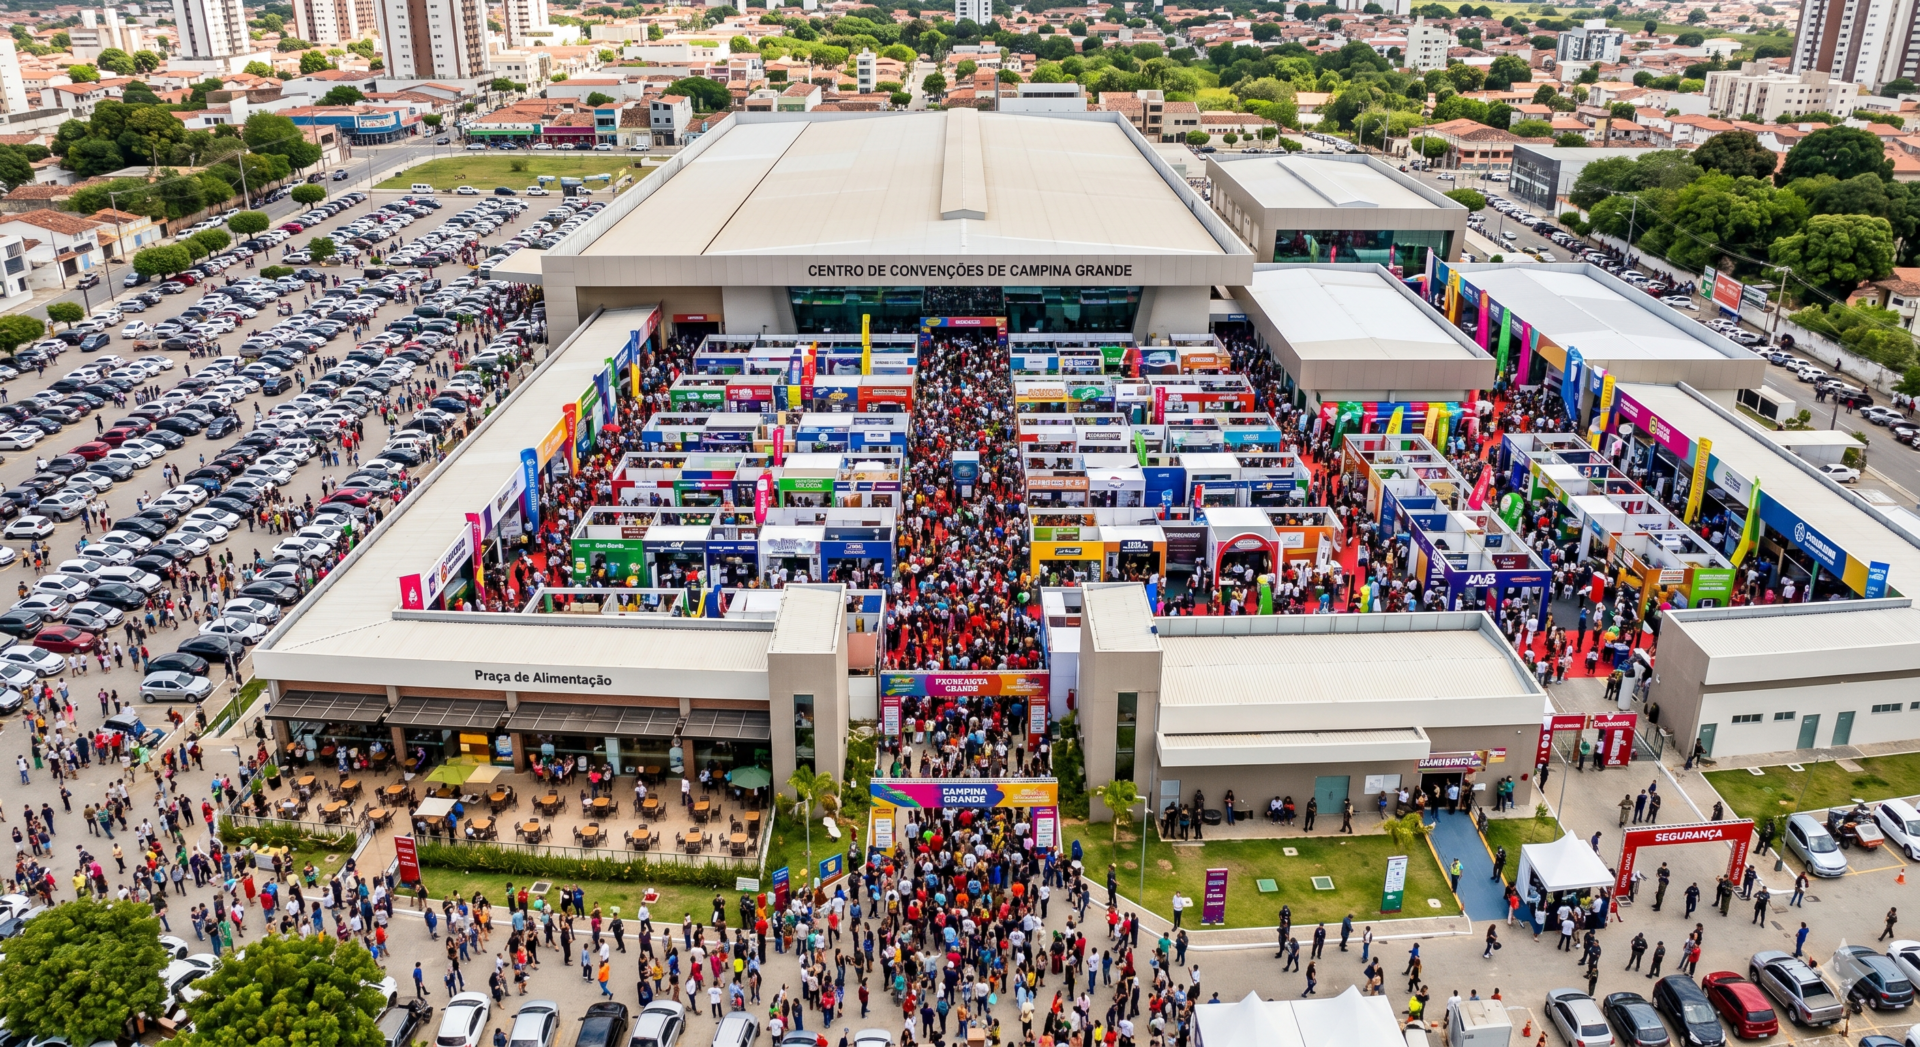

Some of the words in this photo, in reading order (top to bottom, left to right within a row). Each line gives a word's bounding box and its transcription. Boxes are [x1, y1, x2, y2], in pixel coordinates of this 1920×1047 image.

[808, 264, 864, 277] CENTRO
[867, 264, 886, 277] DE
[889, 262, 984, 280] CONVENÇÕES
[988, 264, 1006, 277] DE
[1009, 264, 1072, 277] CAMPINA
[1075, 264, 1132, 277] GRANDE
[474, 669, 511, 684] Praça
[514, 671, 530, 683] de
[533, 672, 612, 688] Alimentação
[942, 787, 988, 796] CAMPINA
[943, 795, 986, 803] GRANDE
[1654, 829, 1723, 842] SEGURANÇA
